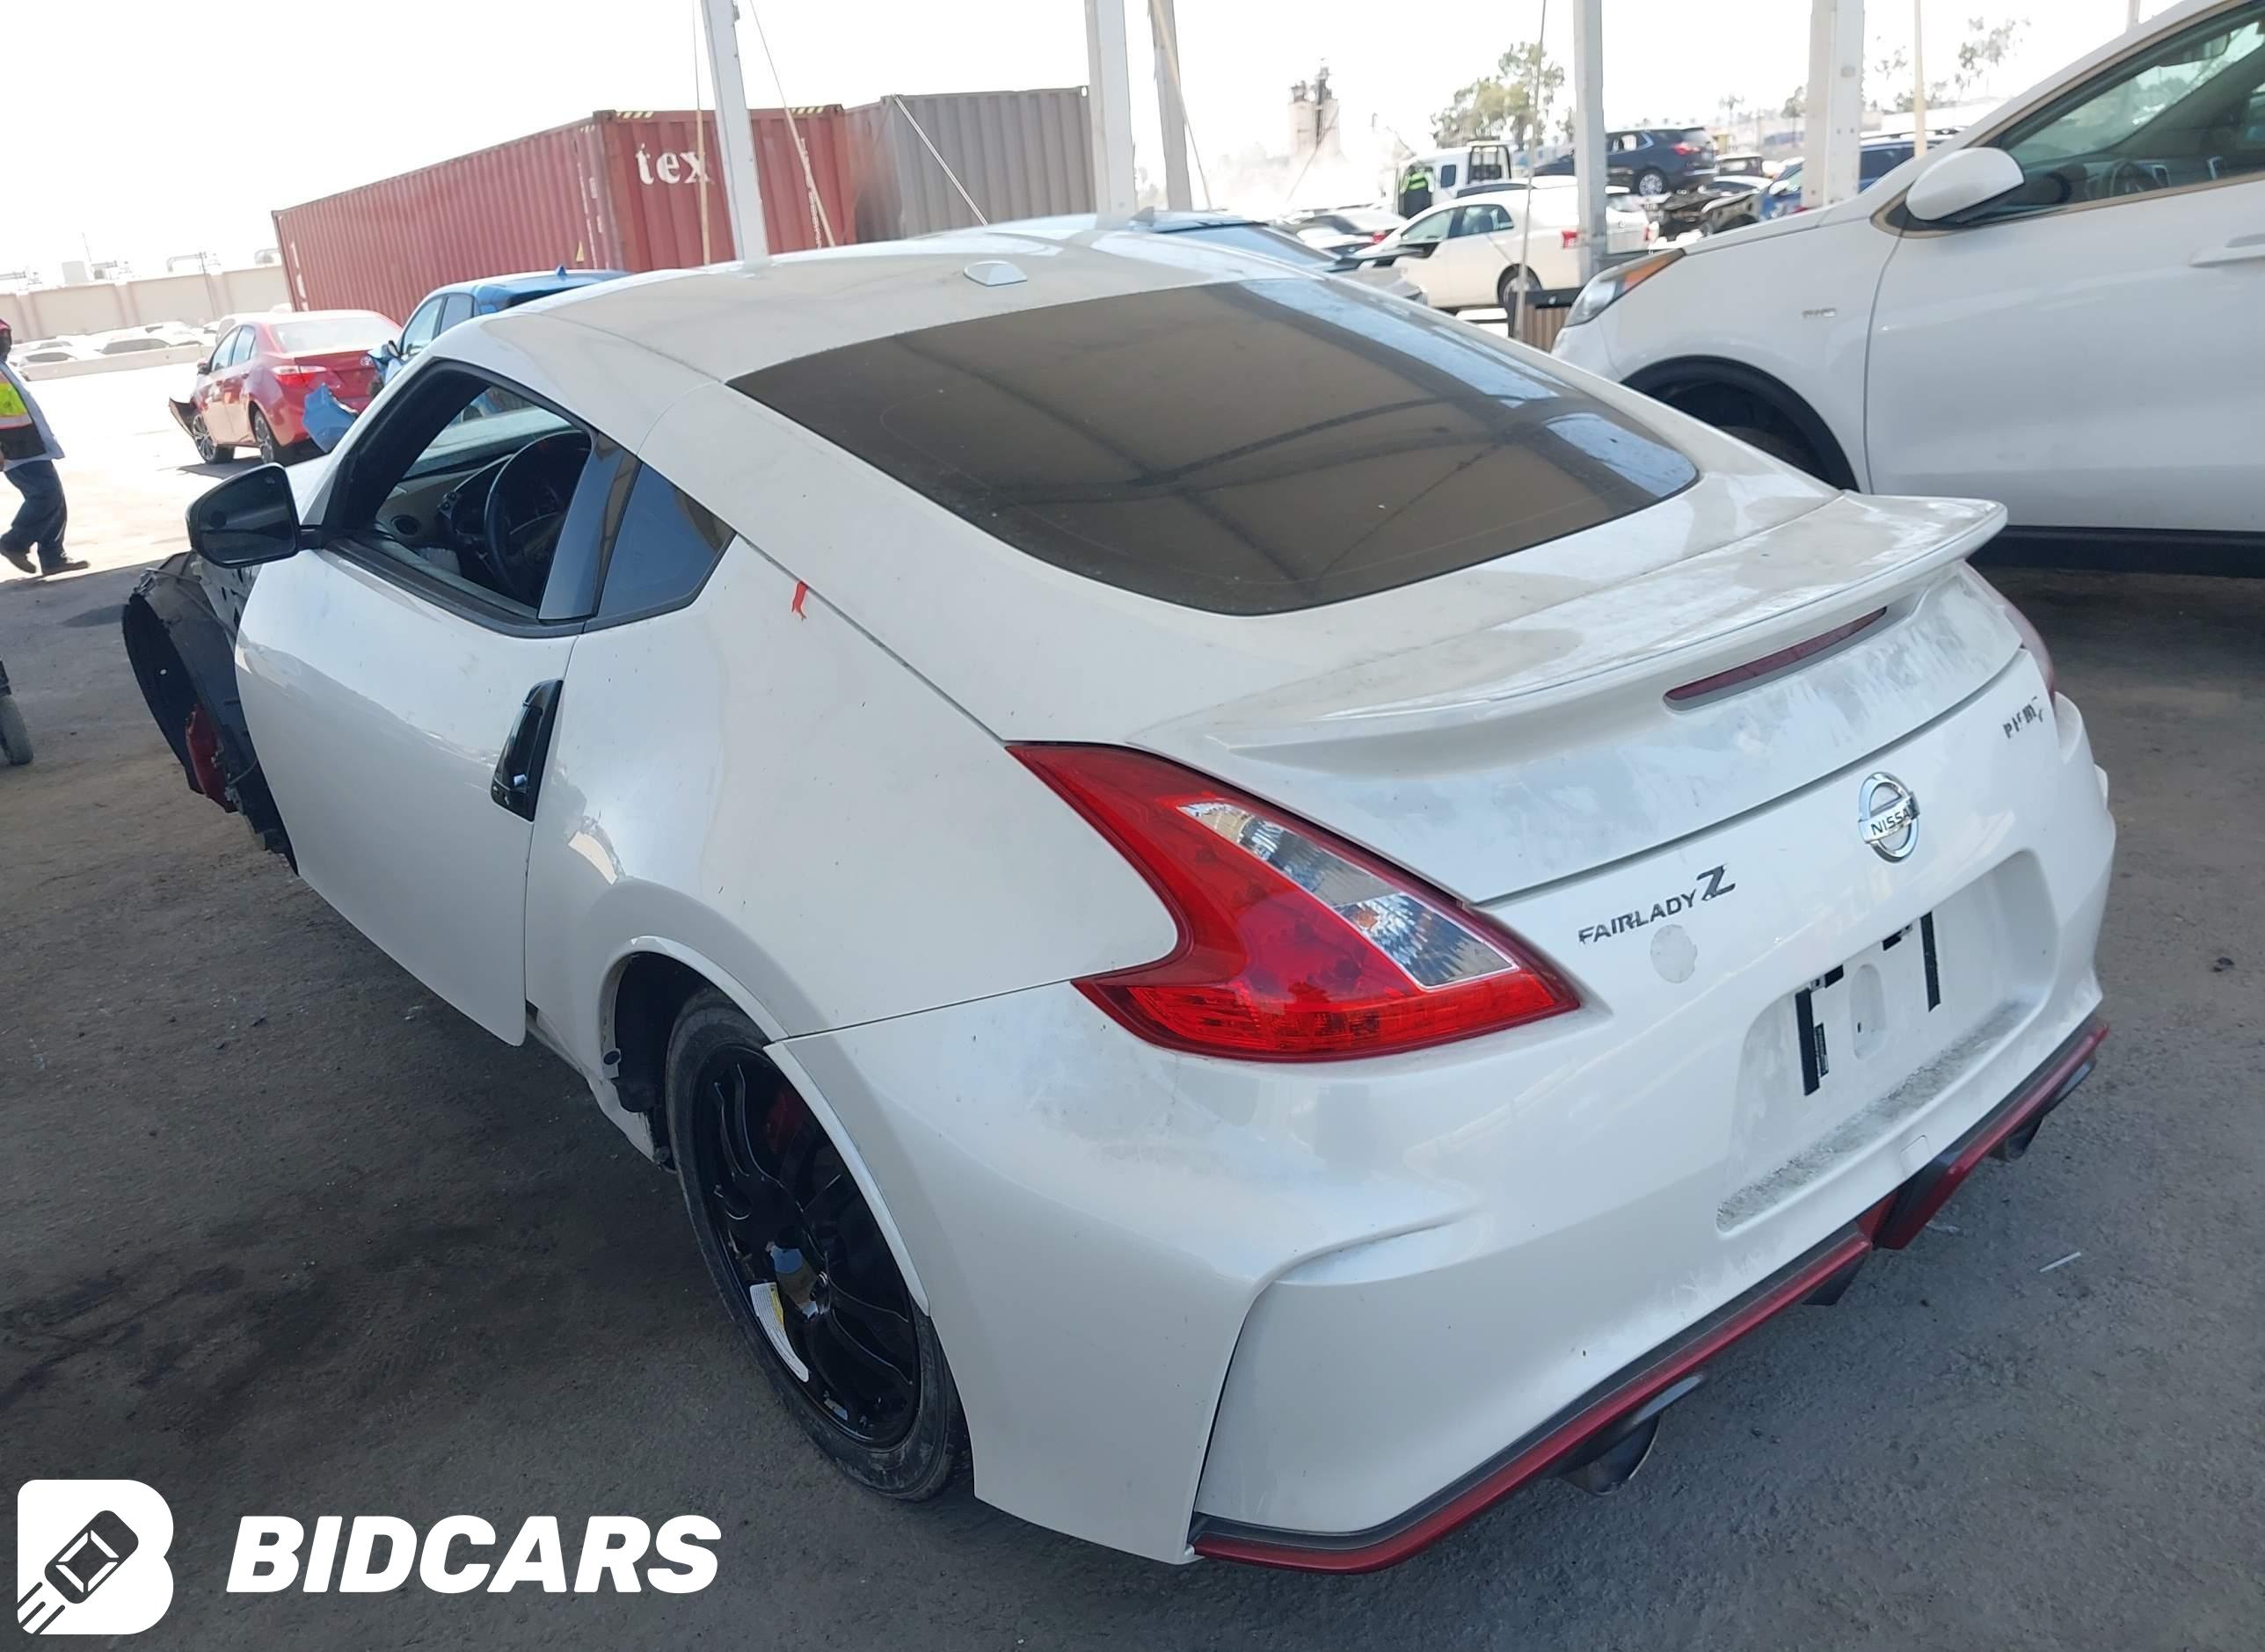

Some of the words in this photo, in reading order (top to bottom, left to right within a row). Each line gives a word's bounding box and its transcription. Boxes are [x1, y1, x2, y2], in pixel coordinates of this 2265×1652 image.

[635, 143, 715, 185] tex
[1577, 888, 1697, 943] FAIRLADY
[1695, 863, 1737, 902] Z
